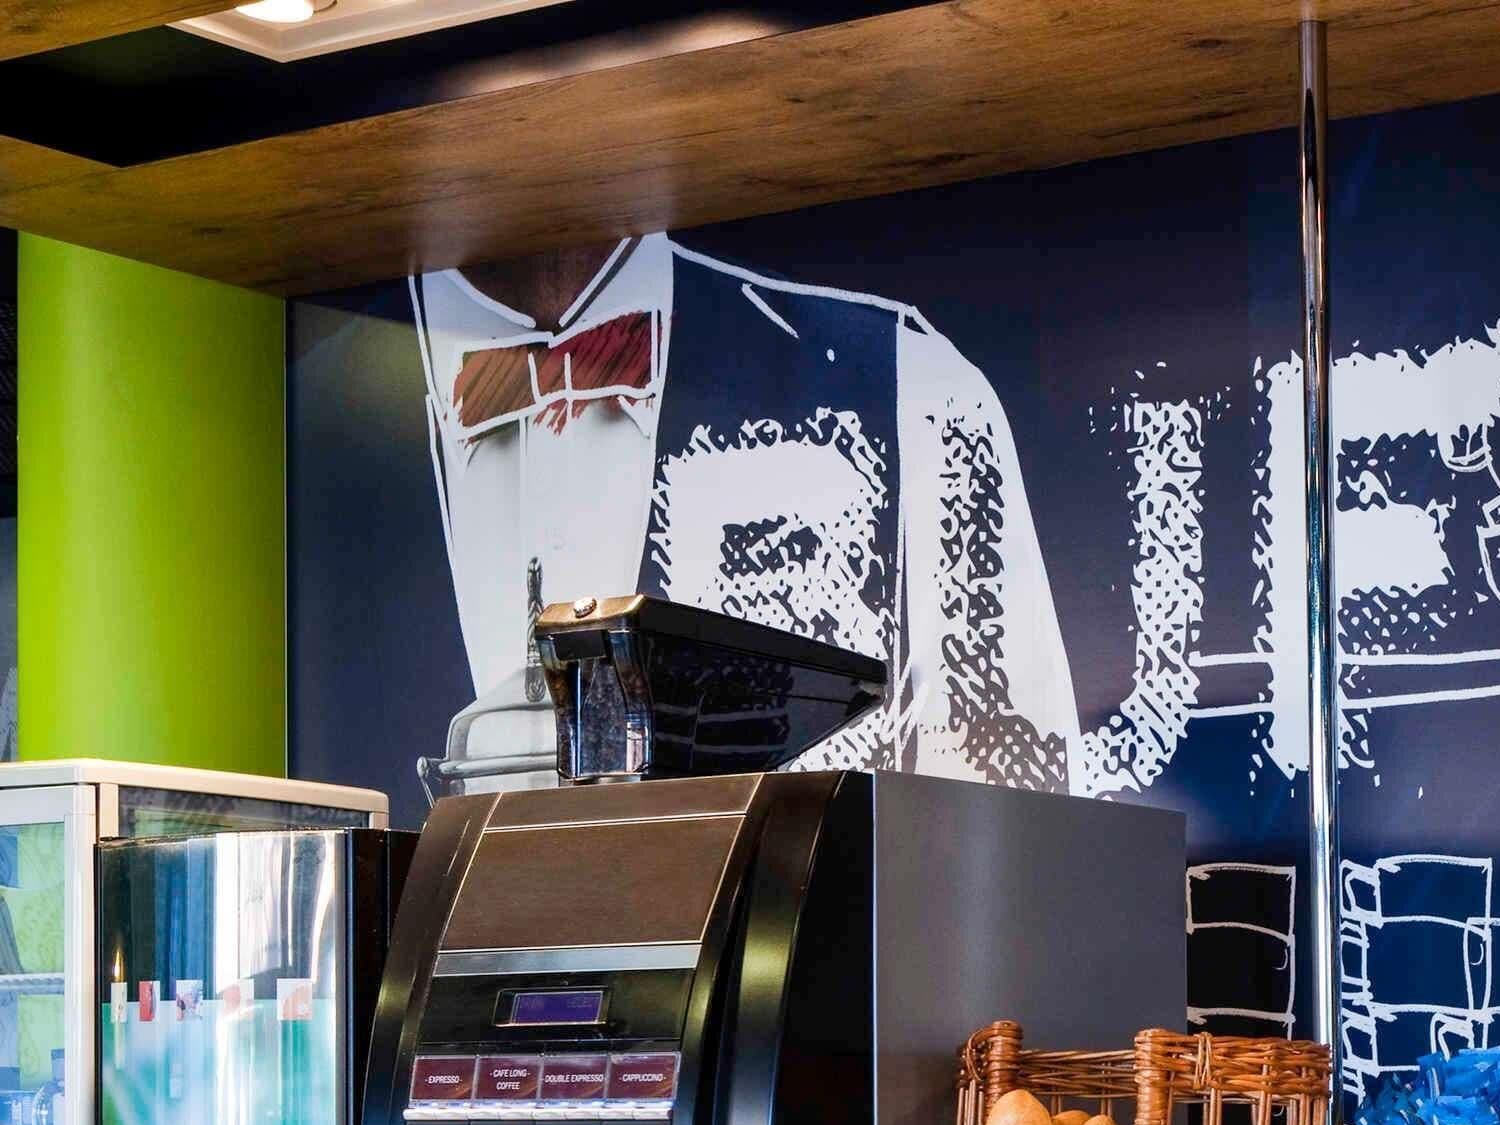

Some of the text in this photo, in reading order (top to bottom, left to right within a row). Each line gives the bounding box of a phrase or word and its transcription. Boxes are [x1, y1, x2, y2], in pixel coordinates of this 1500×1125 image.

[509, 1069, 528, 1078] LONG
[544, 1073, 604, 1083] DOUBLE EXPRESSO
[622, 1073, 664, 1082] CAPPUCCINO
[428, 1075, 460, 1084] EXPRESSO
[496, 1081, 521, 1090] COFFEE
